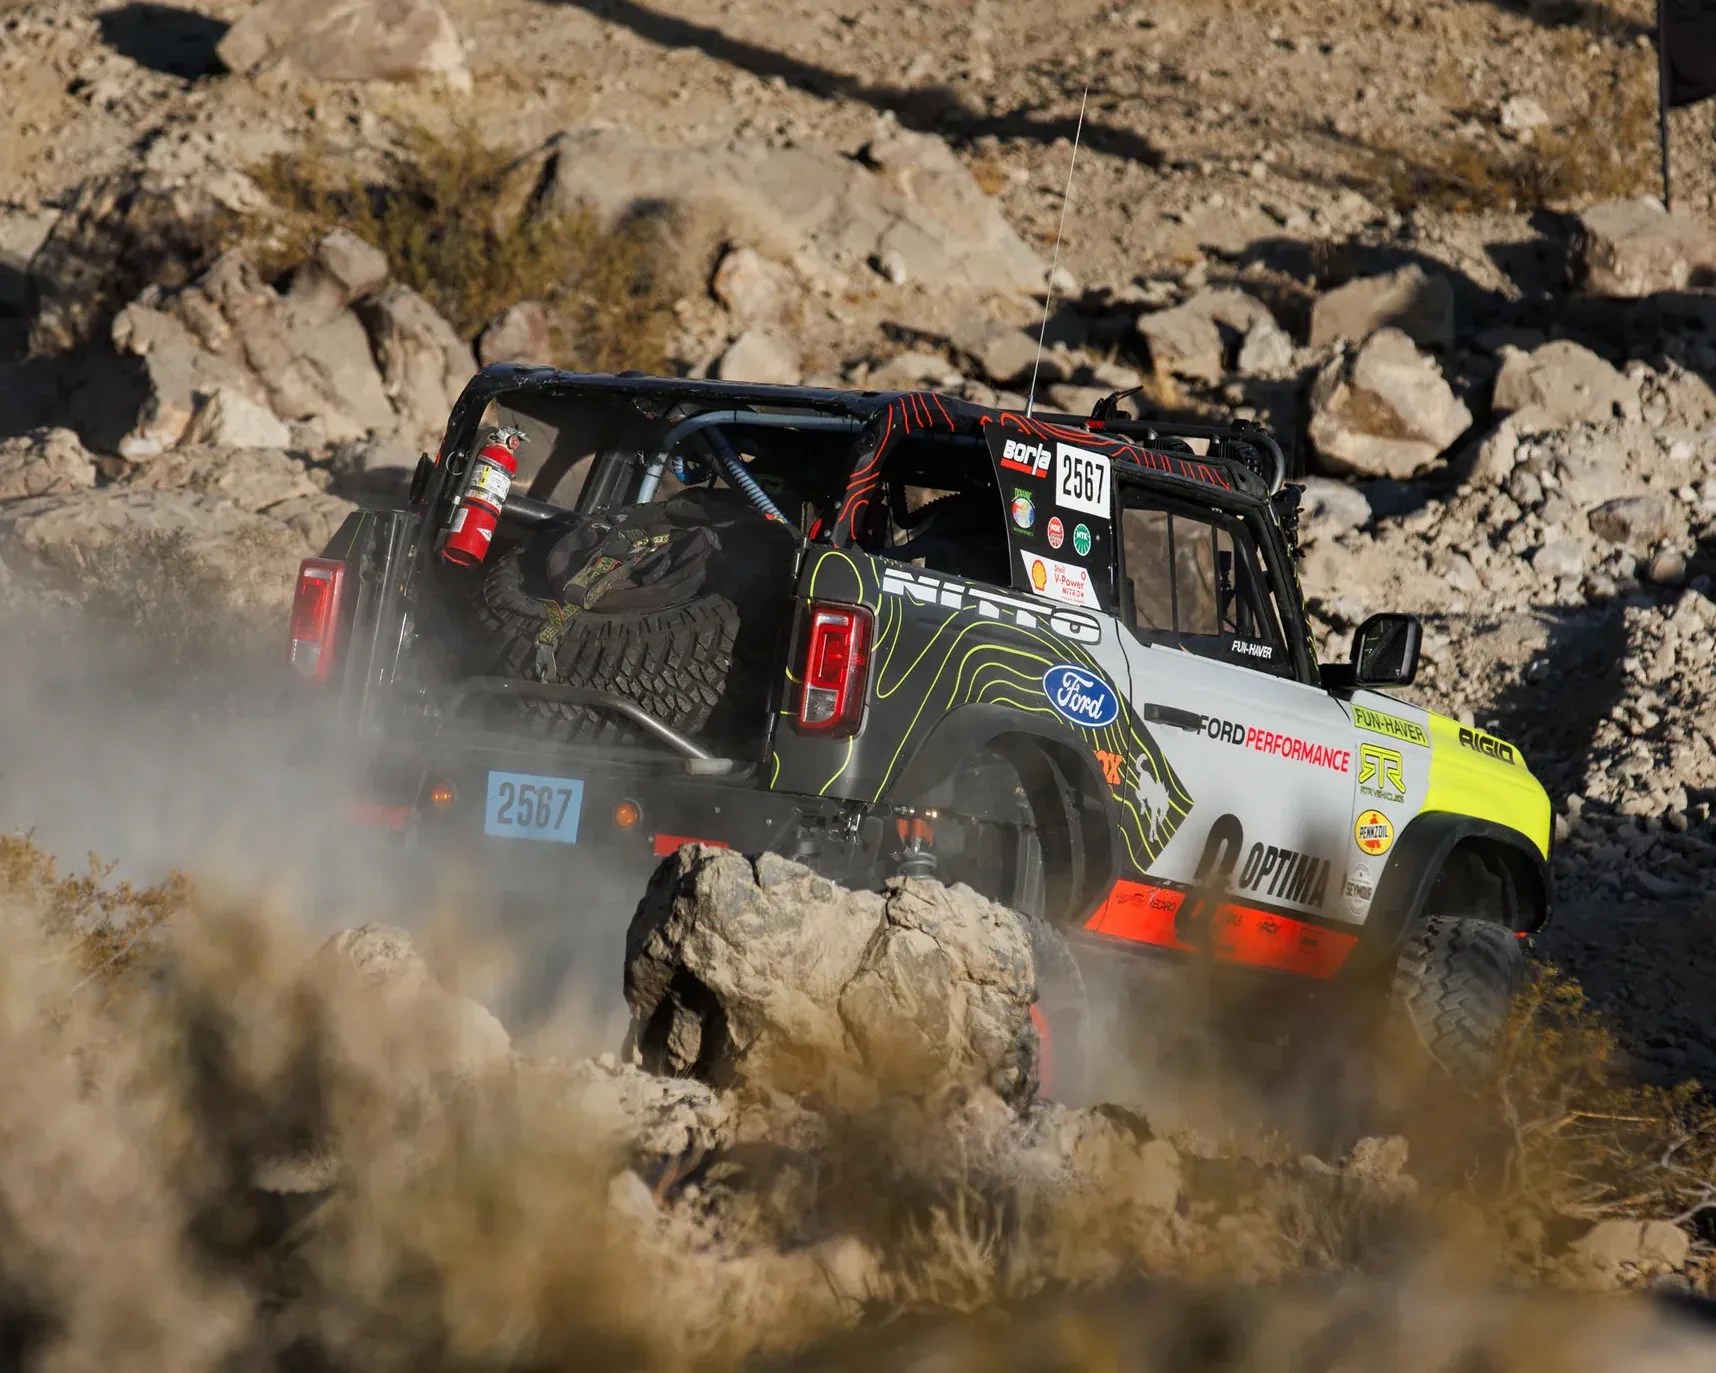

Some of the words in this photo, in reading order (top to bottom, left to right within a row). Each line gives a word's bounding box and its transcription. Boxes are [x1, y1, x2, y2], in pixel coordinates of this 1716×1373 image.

[1062, 454, 1105, 504] 2567
[1054, 564, 1066, 574] Shell
[1054, 573, 1085, 589] V-Power
[882, 568, 1101, 642] NITTO
[1231, 640, 1273, 659] FUN-HAVER
[1057, 671, 1105, 719] Ford
[1355, 707, 1427, 743] FUN-HAVER
[1458, 727, 1516, 765] RIGID
[1245, 727, 1350, 773] PERFORMANCE
[496, 781, 573, 830] 2567
[1359, 824, 1389, 840] PENNZOIL
[1238, 841, 1331, 909] OPTIMA
